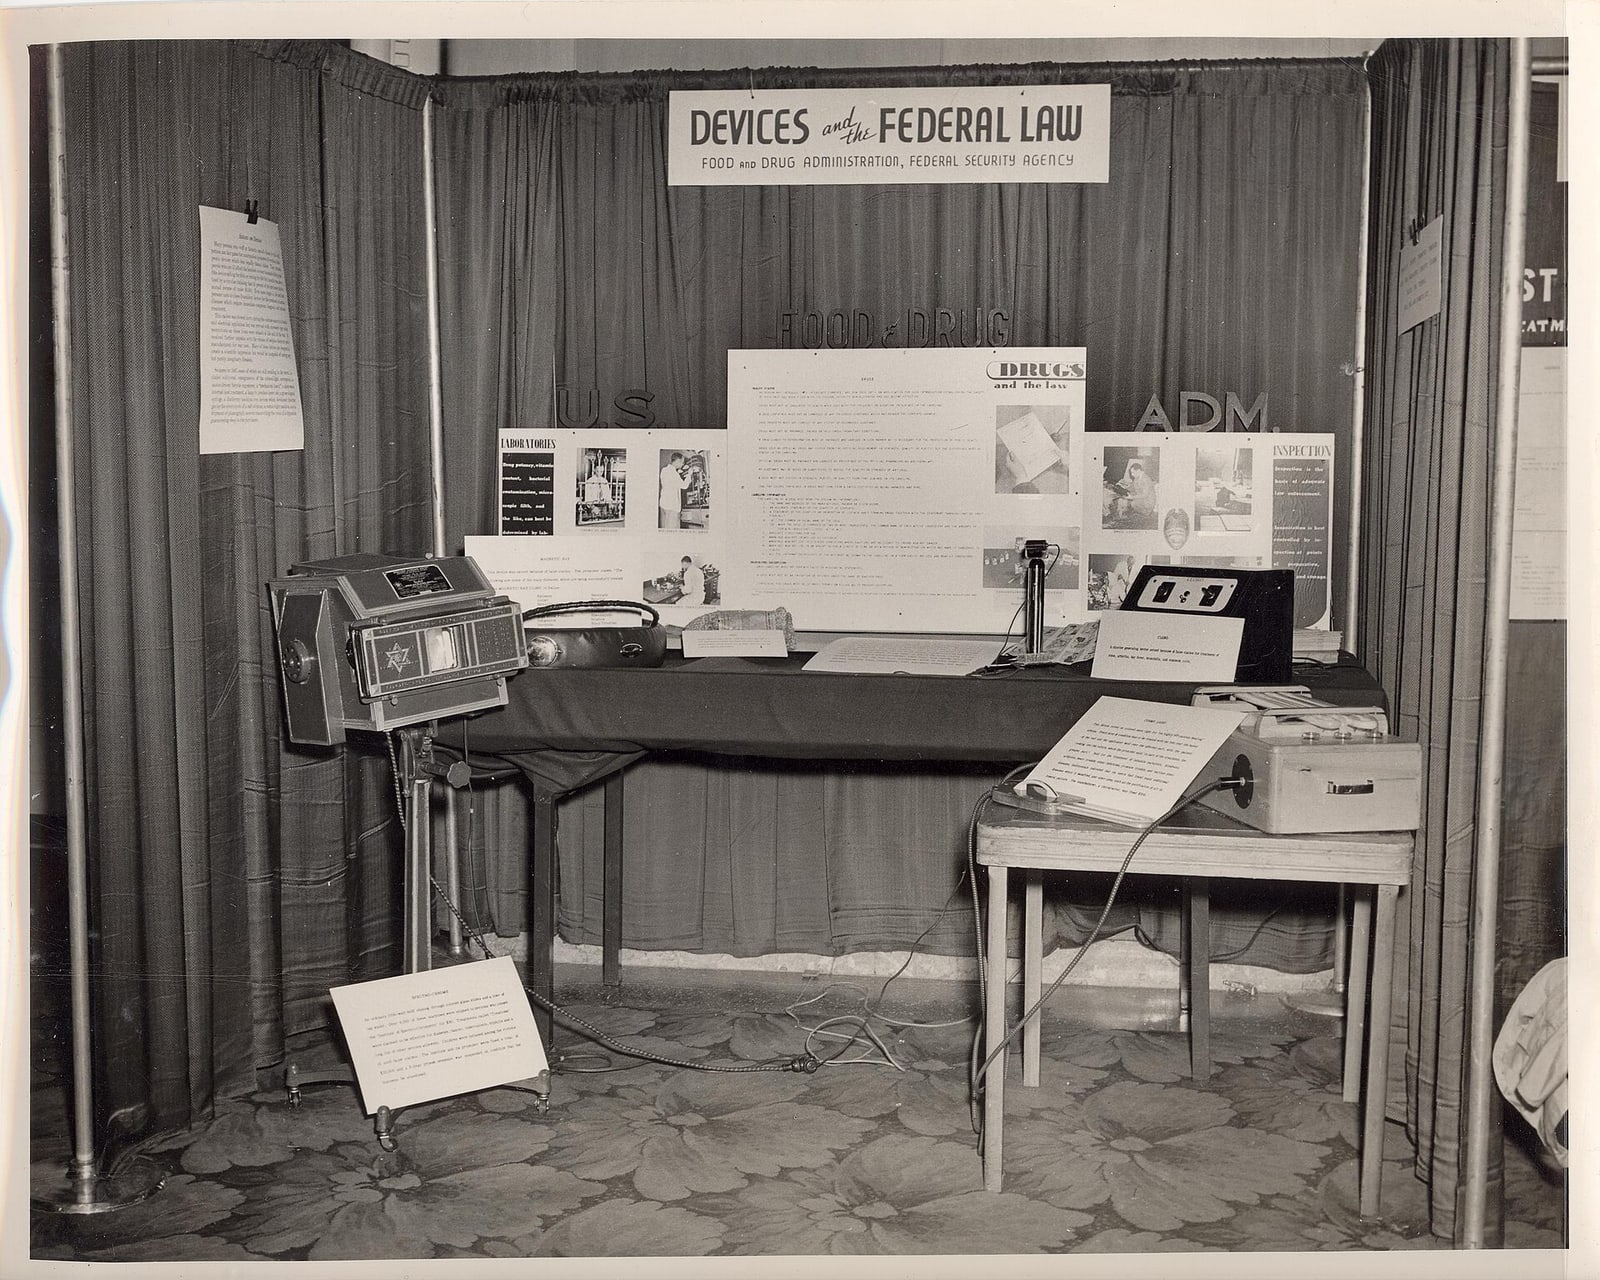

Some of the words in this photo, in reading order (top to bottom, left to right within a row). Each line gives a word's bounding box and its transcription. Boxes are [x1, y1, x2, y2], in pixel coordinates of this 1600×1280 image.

[691, 108, 810, 145] DEVICES
[822, 106, 858, 136] and
[840, 122, 877, 145] the
[879, 106, 1011, 143] FEDERAL
[1020, 105, 1083, 142] LAW
[702, 157, 735, 169] FOOD
[761, 156, 796, 169] DRUG
[803, 155, 905, 169] ADMINISTRATION,
[909, 155, 959, 167] FEDERAL
[964, 154, 1017, 167] SECURITY
[1022, 154, 1075, 167] AGENCY
[776, 308, 875, 349] FOOD
[907, 307, 1010, 348] DRUG
[1000, 363, 1085, 377] DRUGS
[994, 381, 1017, 389] and
[1023, 381, 1042, 389] the
[1046, 381, 1067, 389] law
[1134, 391, 1281, 432] ADM.
[501, 438, 556, 449] LABORATORIES
[1273, 445, 1331, 456] INSPECTION
